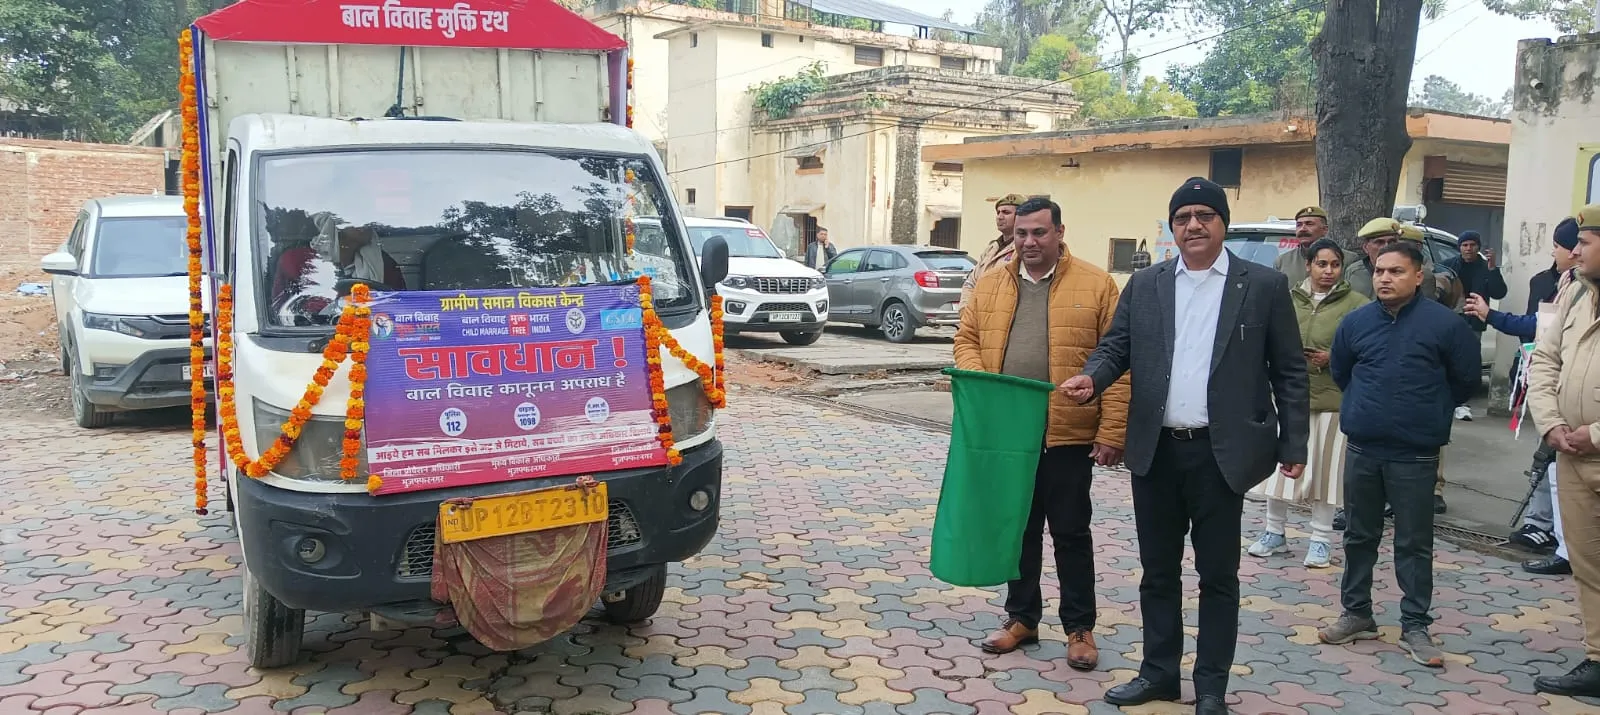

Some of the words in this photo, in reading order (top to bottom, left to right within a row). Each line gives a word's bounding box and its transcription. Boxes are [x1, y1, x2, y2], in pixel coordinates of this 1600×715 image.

[340, 5, 380, 28] बाल
[382, 0, 433, 30] विवाह
[435, 2, 478, 38] मुक्ति
[480, 10, 509, 32] रथ
[440, 293, 479, 311] ग्रामीण
[482, 295, 515, 309] समाज
[518, 292, 557, 308] विकास
[559, 291, 585, 307] केन्द्र
[395, 313, 413, 323] बाल
[415, 311, 440, 322] विवाह
[462, 315, 479, 324] बाल
[482, 313, 507, 324] विवाह
[510, 314, 527, 325] मुक्त
[530, 313, 549, 323] भारत
[462, 328, 479, 336] CHILD
[480, 327, 509, 336] MARRIAGE
[512, 326, 527, 334] FREE
[531, 325, 551, 334] INDIA
[398, 339, 598, 380] सावधान
[612, 336, 628, 368] !
[406, 386, 441, 401] बाल
[448, 382, 493, 399] विवाह
[499, 379, 555, 398] कानूनन
[561, 375, 611, 391] अपराध
[614, 371, 626, 386] है
[446, 421, 461, 432] 112
[519, 417, 536, 426] 1098
[376, 447, 399, 460] आइये
[402, 449, 414, 458] हम
[417, 448, 430, 457] सब
[433, 444, 462, 456] मिलकर
[465, 442, 478, 454] इसे
